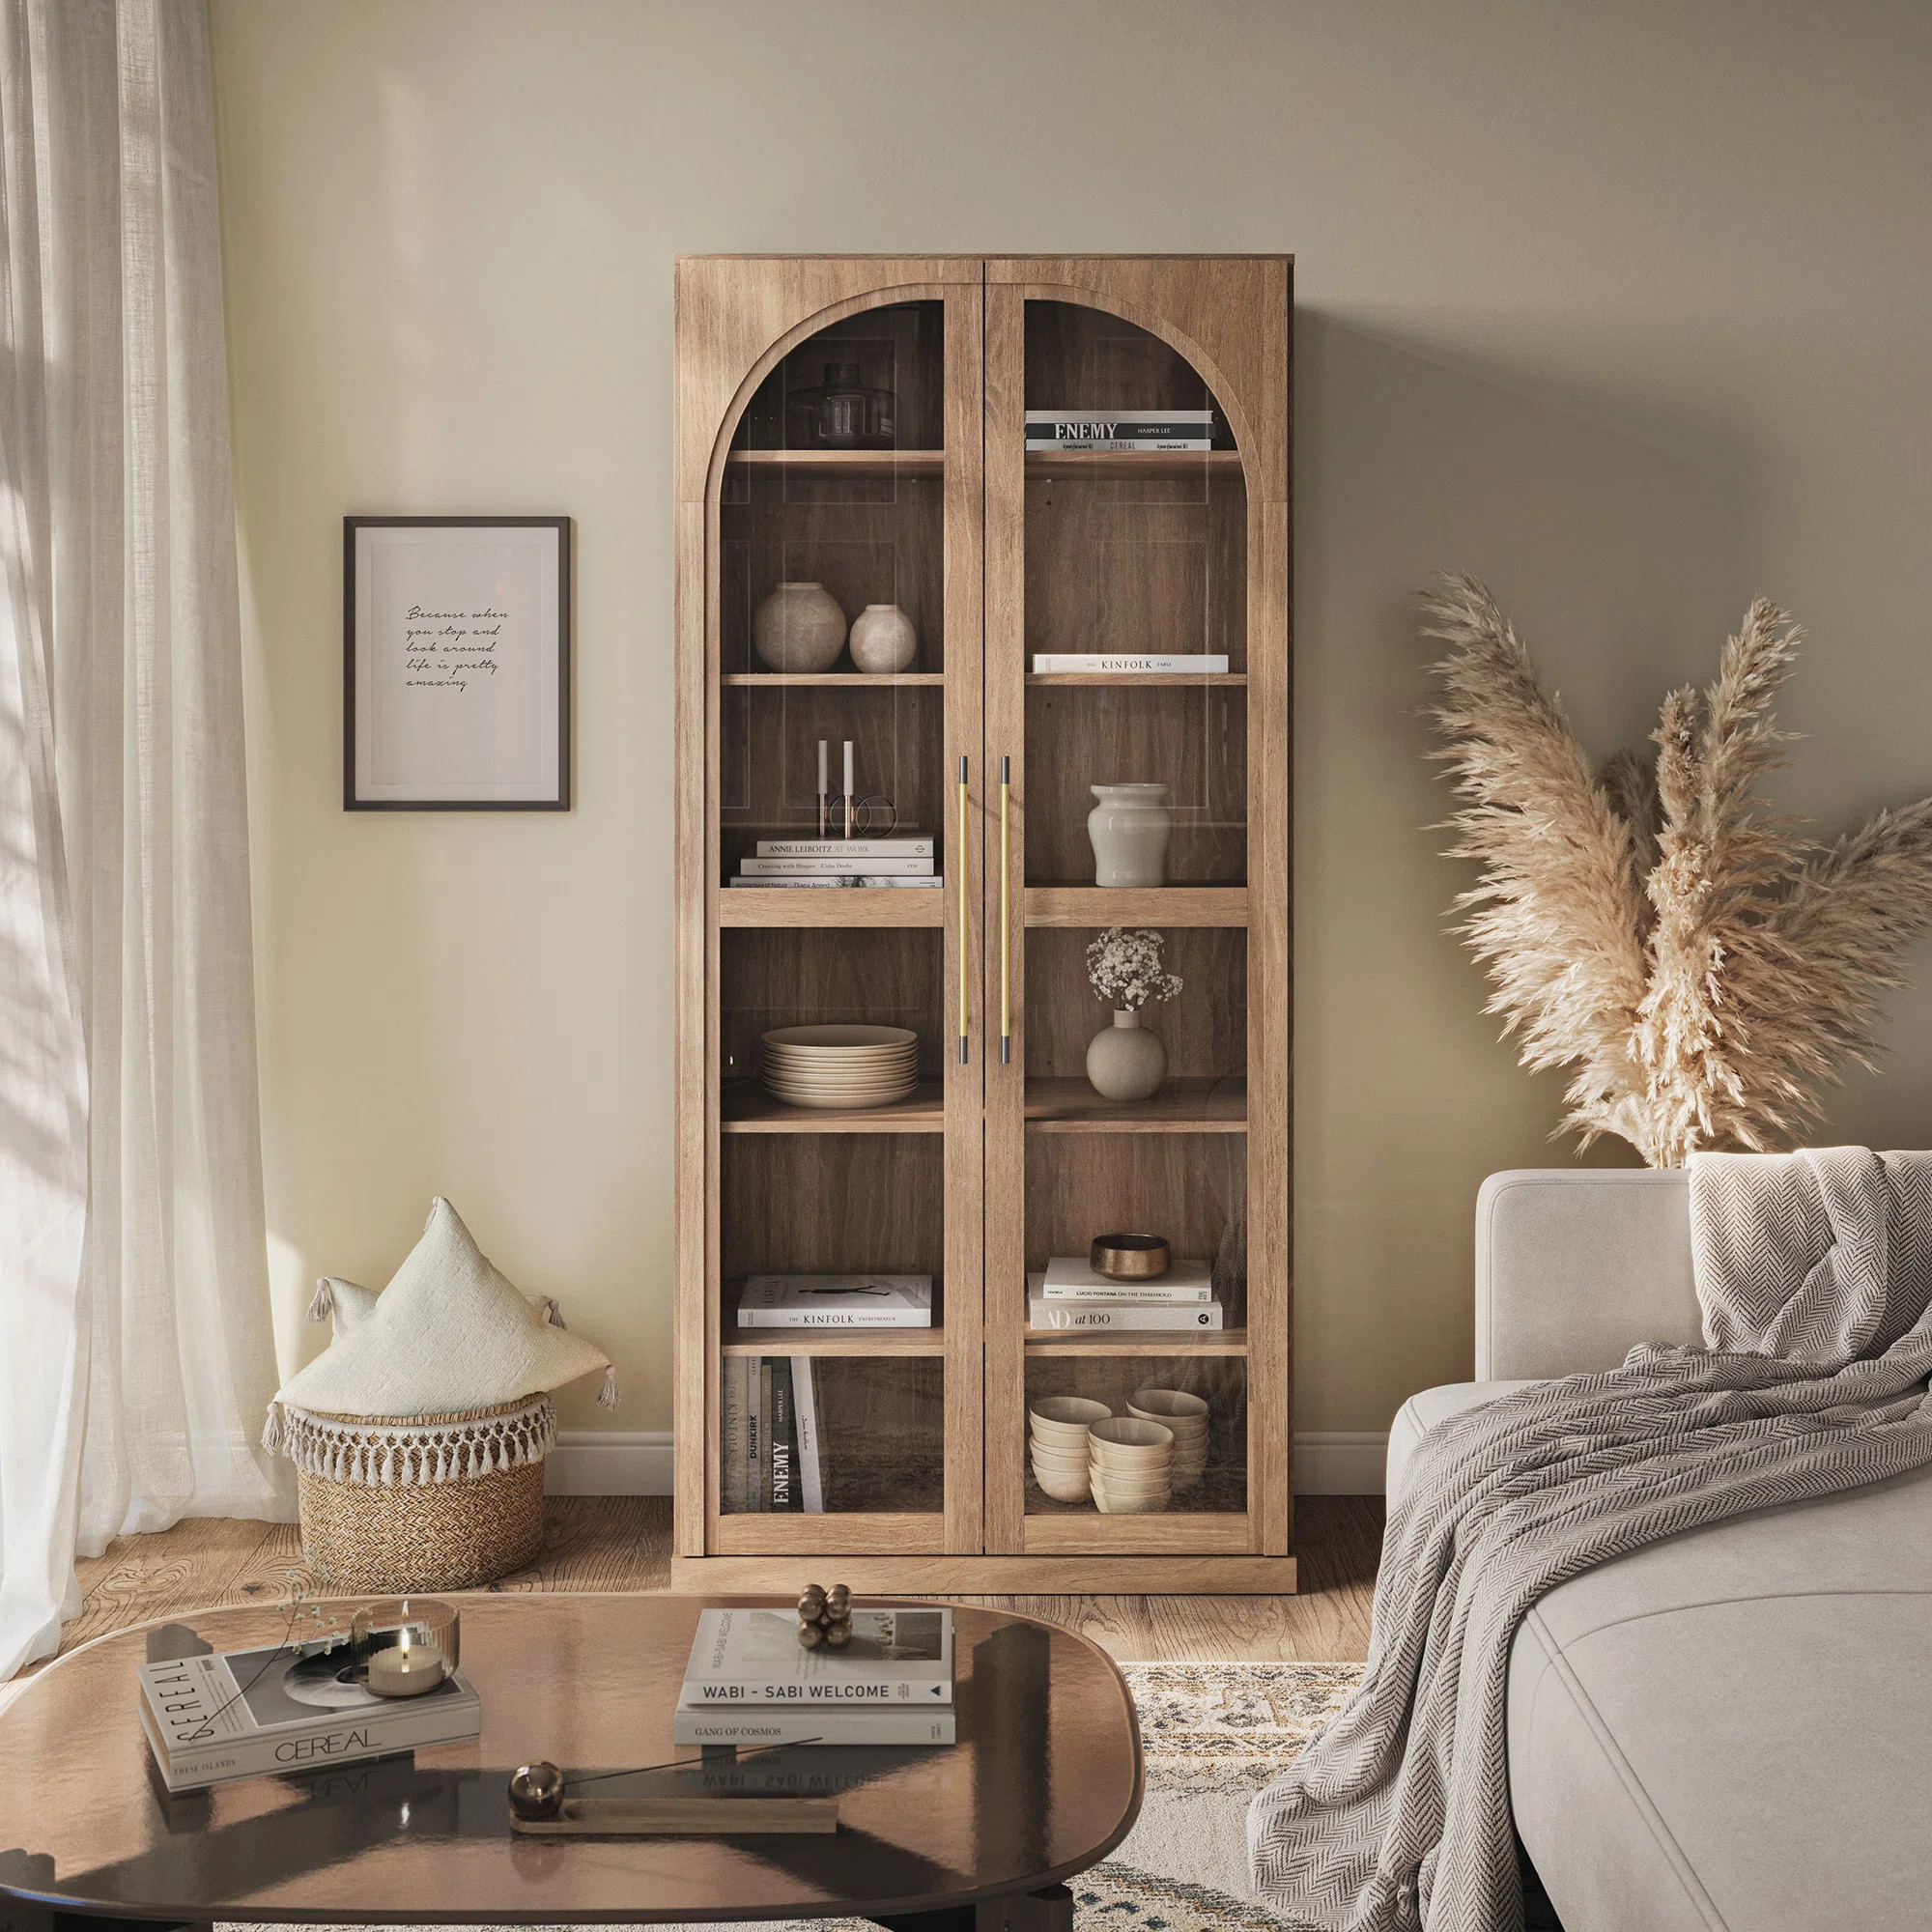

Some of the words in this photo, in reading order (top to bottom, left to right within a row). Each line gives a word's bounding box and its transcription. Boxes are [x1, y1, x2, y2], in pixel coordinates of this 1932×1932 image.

[1054, 423, 1118, 439] ENEMY
[1110, 441, 1135, 450] CEREAL
[406, 605, 467, 620] Because
[471, 608, 509, 619] when
[406, 628, 433, 641] you
[438, 625, 468, 641] stop
[472, 624, 501, 636] and
[406, 641, 438, 653] look
[442, 641, 497, 653] around
[406, 658, 432, 672] life
[437, 659, 450, 669] is
[452, 659, 499, 676] pretty
[1101, 660, 1152, 669] KINFOLK
[406, 675, 469, 693] amazing
[804, 1315, 854, 1324] KINFOLK
[1074, 1315, 1086, 1324] at
[1089, 1314, 1110, 1324] 100
[728, 1404, 738, 1456] KINFOLK
[774, 1441, 789, 1503] ENEMY
[703, 1685, 745, 1698] WABI
[765, 1685, 803, 1698] SABI
[809, 1685, 890, 1698] WELCOME
[149, 1662, 216, 1742] CEREAL
[695, 1727, 724, 1737] GANG
[725, 1727, 739, 1736] OF
[741, 1727, 781, 1737] COSMOS
[275, 1729, 382, 1762] CEREAL
[174, 1765, 198, 1776] THESE
[202, 1759, 236, 1771] ISLANDS
